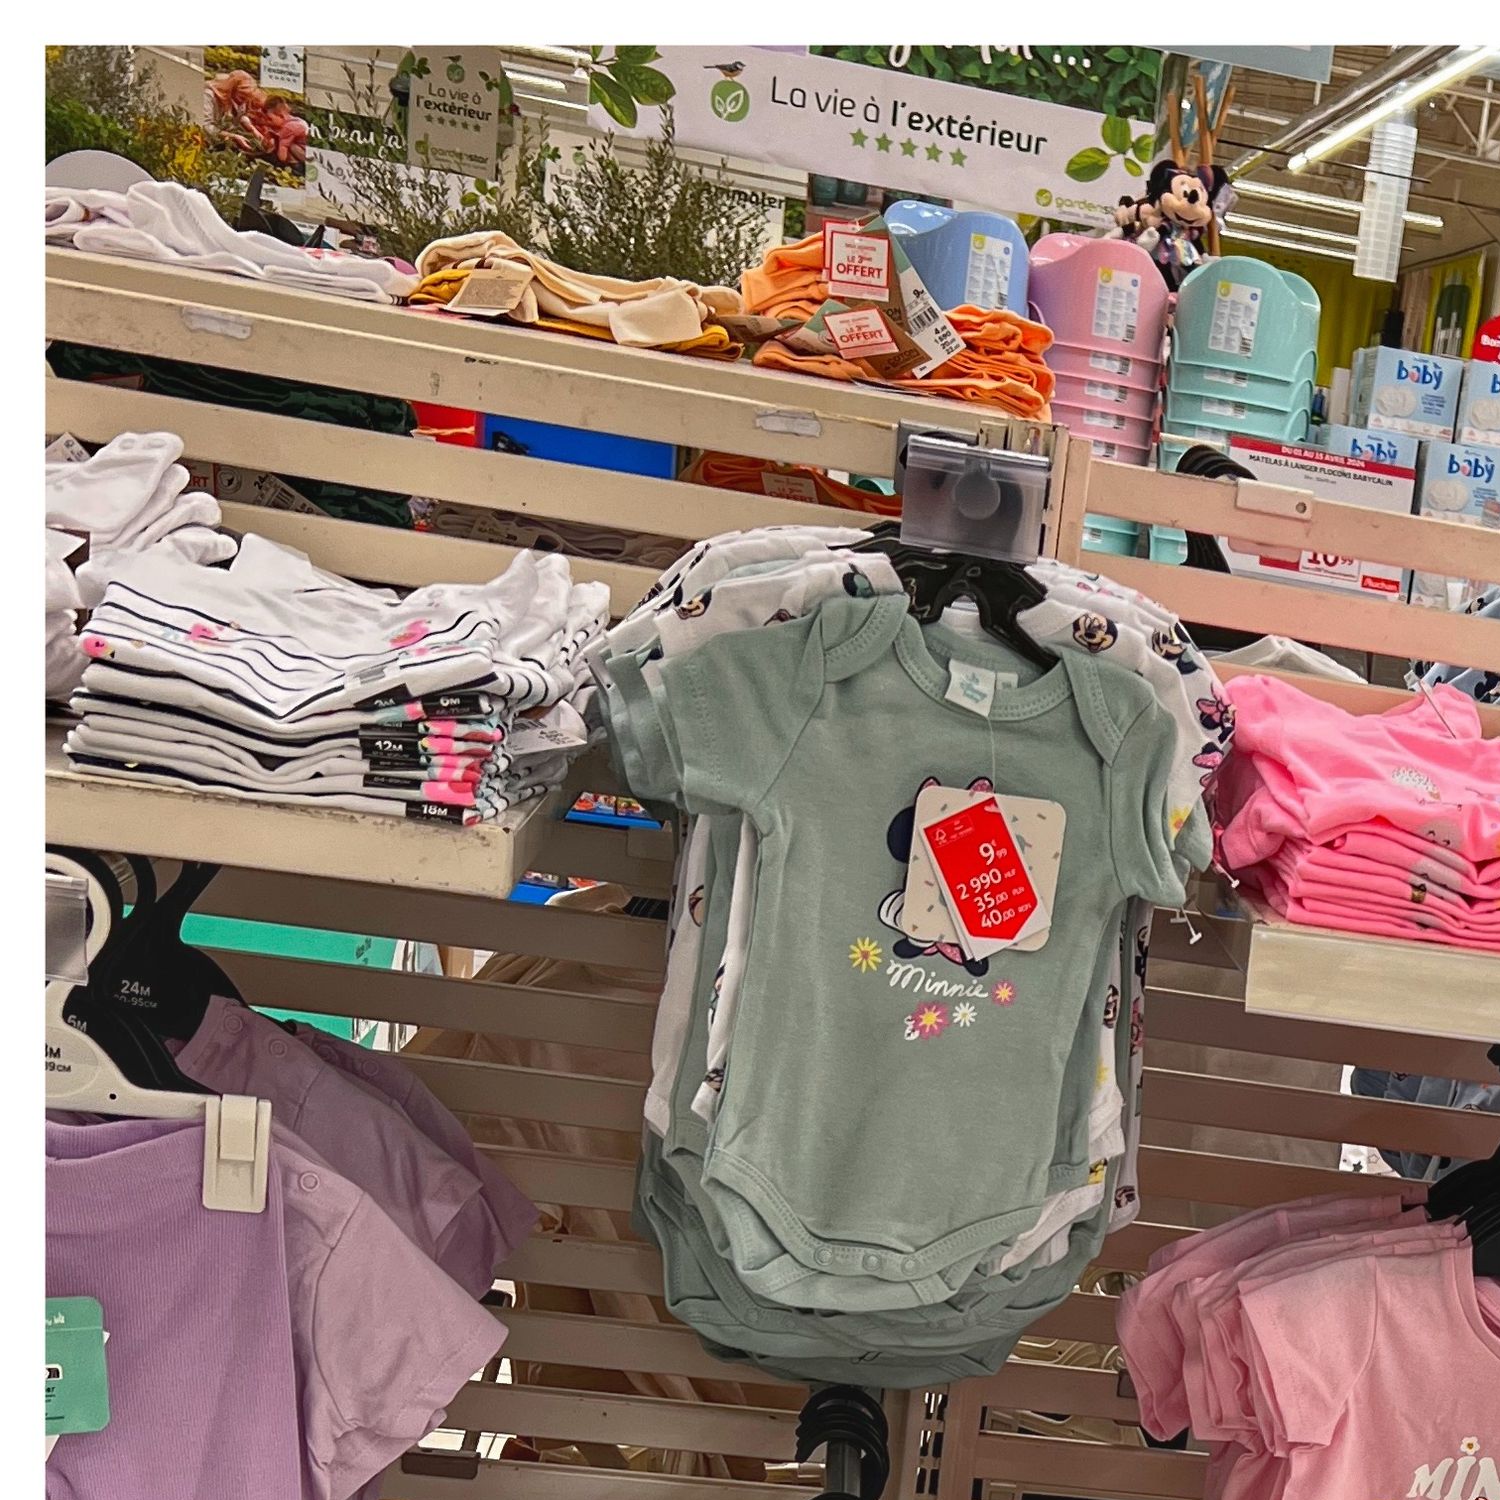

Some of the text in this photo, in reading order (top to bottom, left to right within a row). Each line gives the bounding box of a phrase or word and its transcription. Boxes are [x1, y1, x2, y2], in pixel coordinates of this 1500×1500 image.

[428, 82, 446, 98] La
[448, 87, 471, 103] vie
[416, 95, 492, 122] l'extérieur
[770, 75, 1049, 155] La vie à l'extérieur
[836, 263, 883, 279] OFFERT
[839, 330, 883, 343] OFFERT
[1397, 360, 1443, 390] baby
[1249, 454, 1284, 467] MATELAS
[1290, 461, 1318, 473] LANGER
[1319, 466, 1352, 479] FLOCONS
[1448, 454, 1495, 483] baby
[375, 740, 403, 752] 12M
[421, 804, 449, 816] 18M
[121, 980, 151, 996] 24M
[886, 960, 989, 999] Minnie
